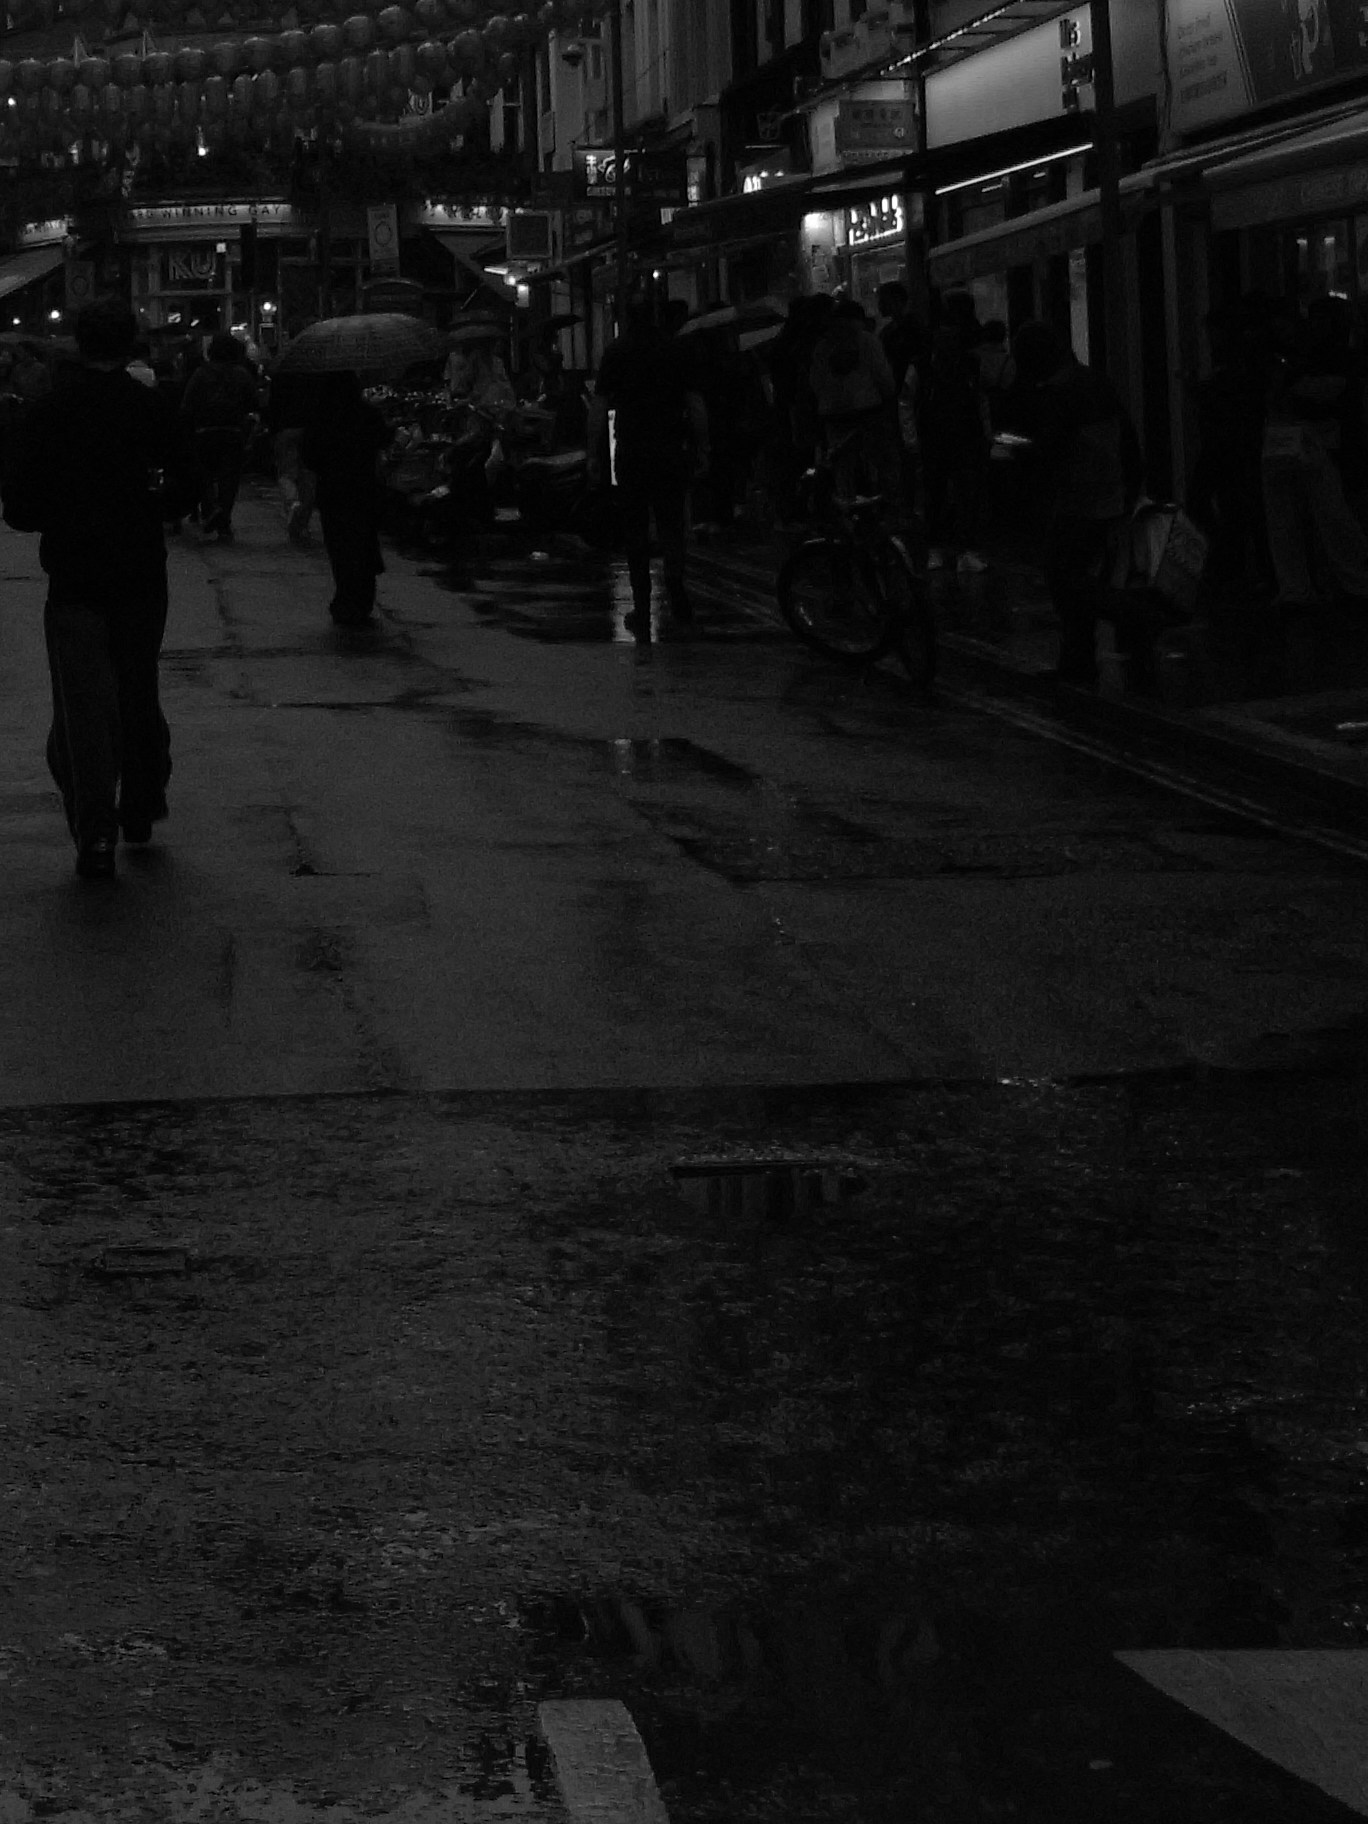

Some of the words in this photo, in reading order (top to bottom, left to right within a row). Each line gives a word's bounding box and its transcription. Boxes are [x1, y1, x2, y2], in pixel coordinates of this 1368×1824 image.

[162, 205, 238, 219] WINNING
[248, 203, 281, 217] GAY
[168, 246, 217, 282] KU
